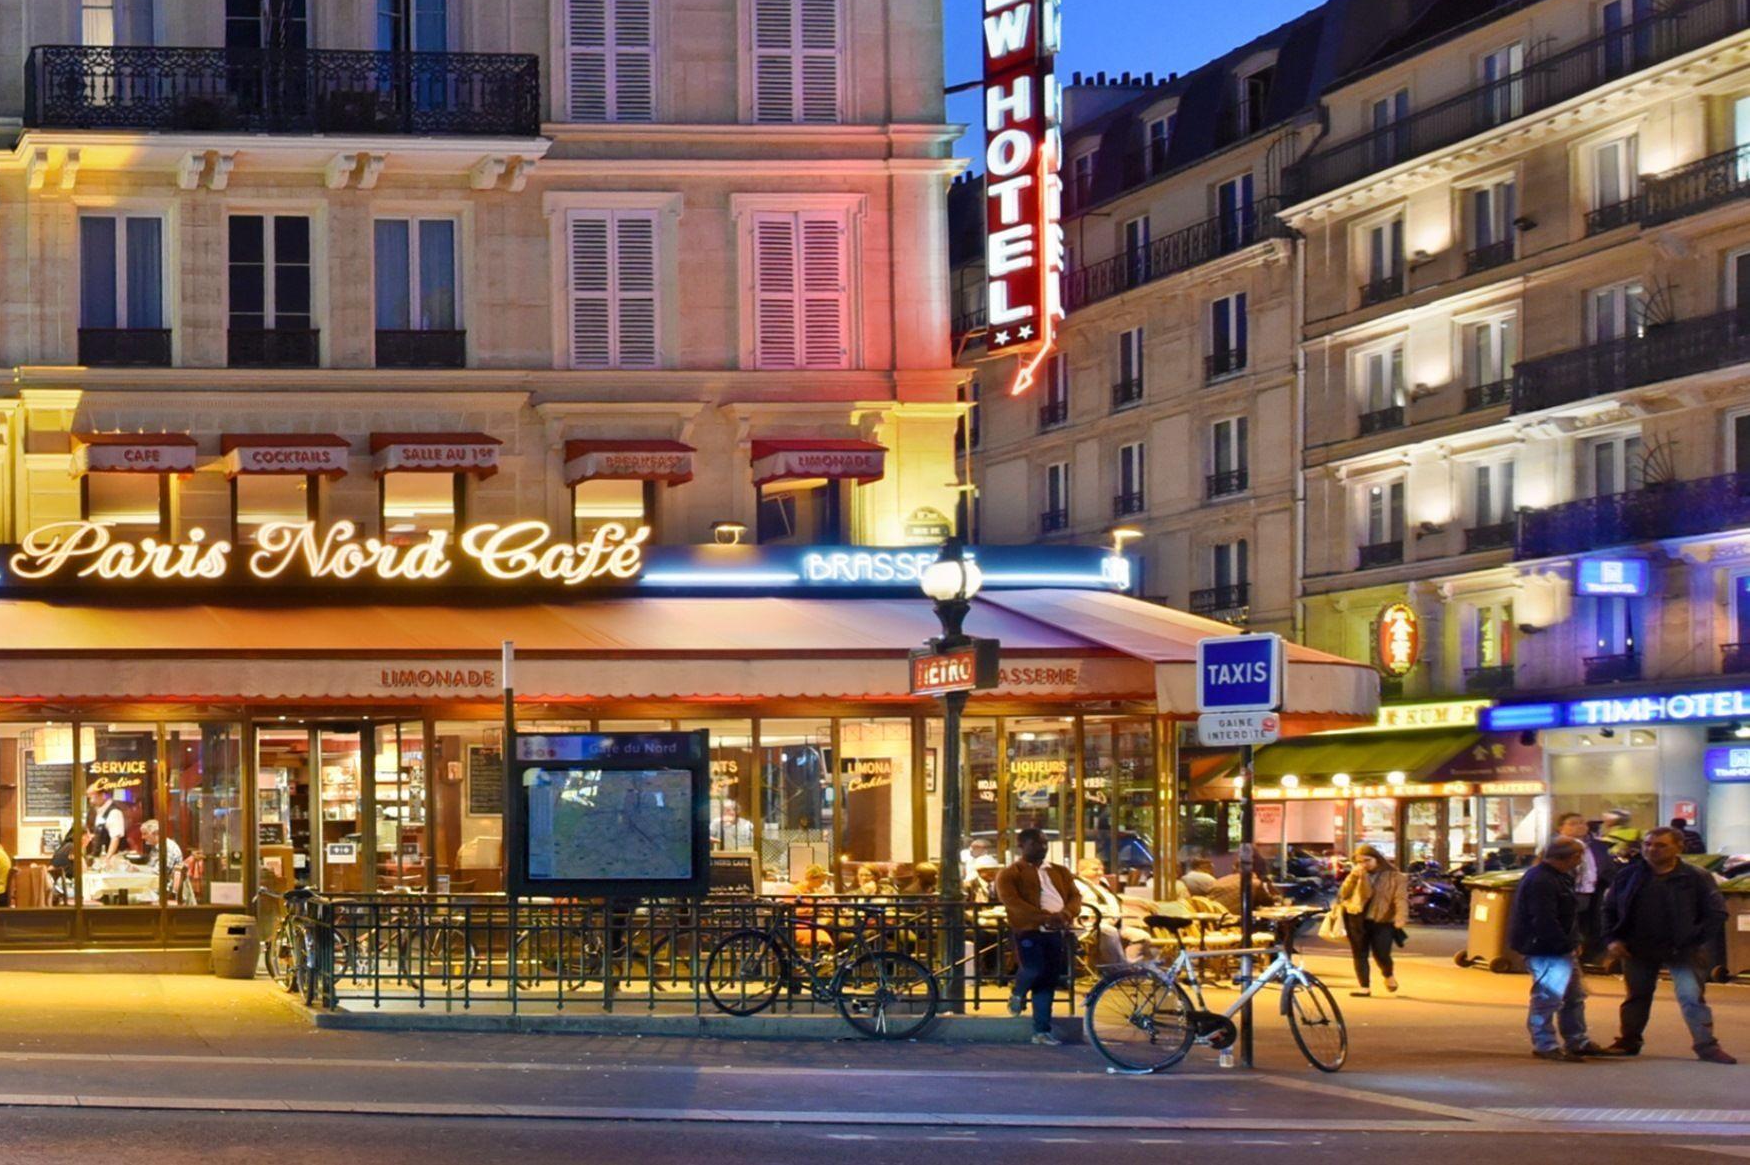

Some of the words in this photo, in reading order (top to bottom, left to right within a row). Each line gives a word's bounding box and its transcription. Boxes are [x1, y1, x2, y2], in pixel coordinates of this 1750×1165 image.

[987, 75, 1033, 326] HOTEL
[124, 449, 160, 463] CAFE
[252, 449, 331, 464] COCKTAILS
[402, 448, 442, 461] SALLE
[446, 448, 467, 461] AU
[605, 455, 682, 468] BREAKFAST
[799, 455, 872, 468] LIMONADE
[10, 520, 232, 580] Paris
[249, 519, 452, 581] Nord
[461, 520, 652, 585] Café
[807, 551, 975, 582] BRASSE
[381, 669, 496, 688] LIMONADE
[999, 667, 1078, 686] ASSERIE
[1207, 660, 1269, 687] TAXIS
[1580, 689, 1750, 725] TIMHOTEL
[1207, 729, 1268, 741] INTERDITE
[624, 742, 640, 754] du
[644, 742, 677, 754] Nord
[92, 760, 146, 774] SERVICE
[1011, 760, 1067, 774] LIQUEURS
